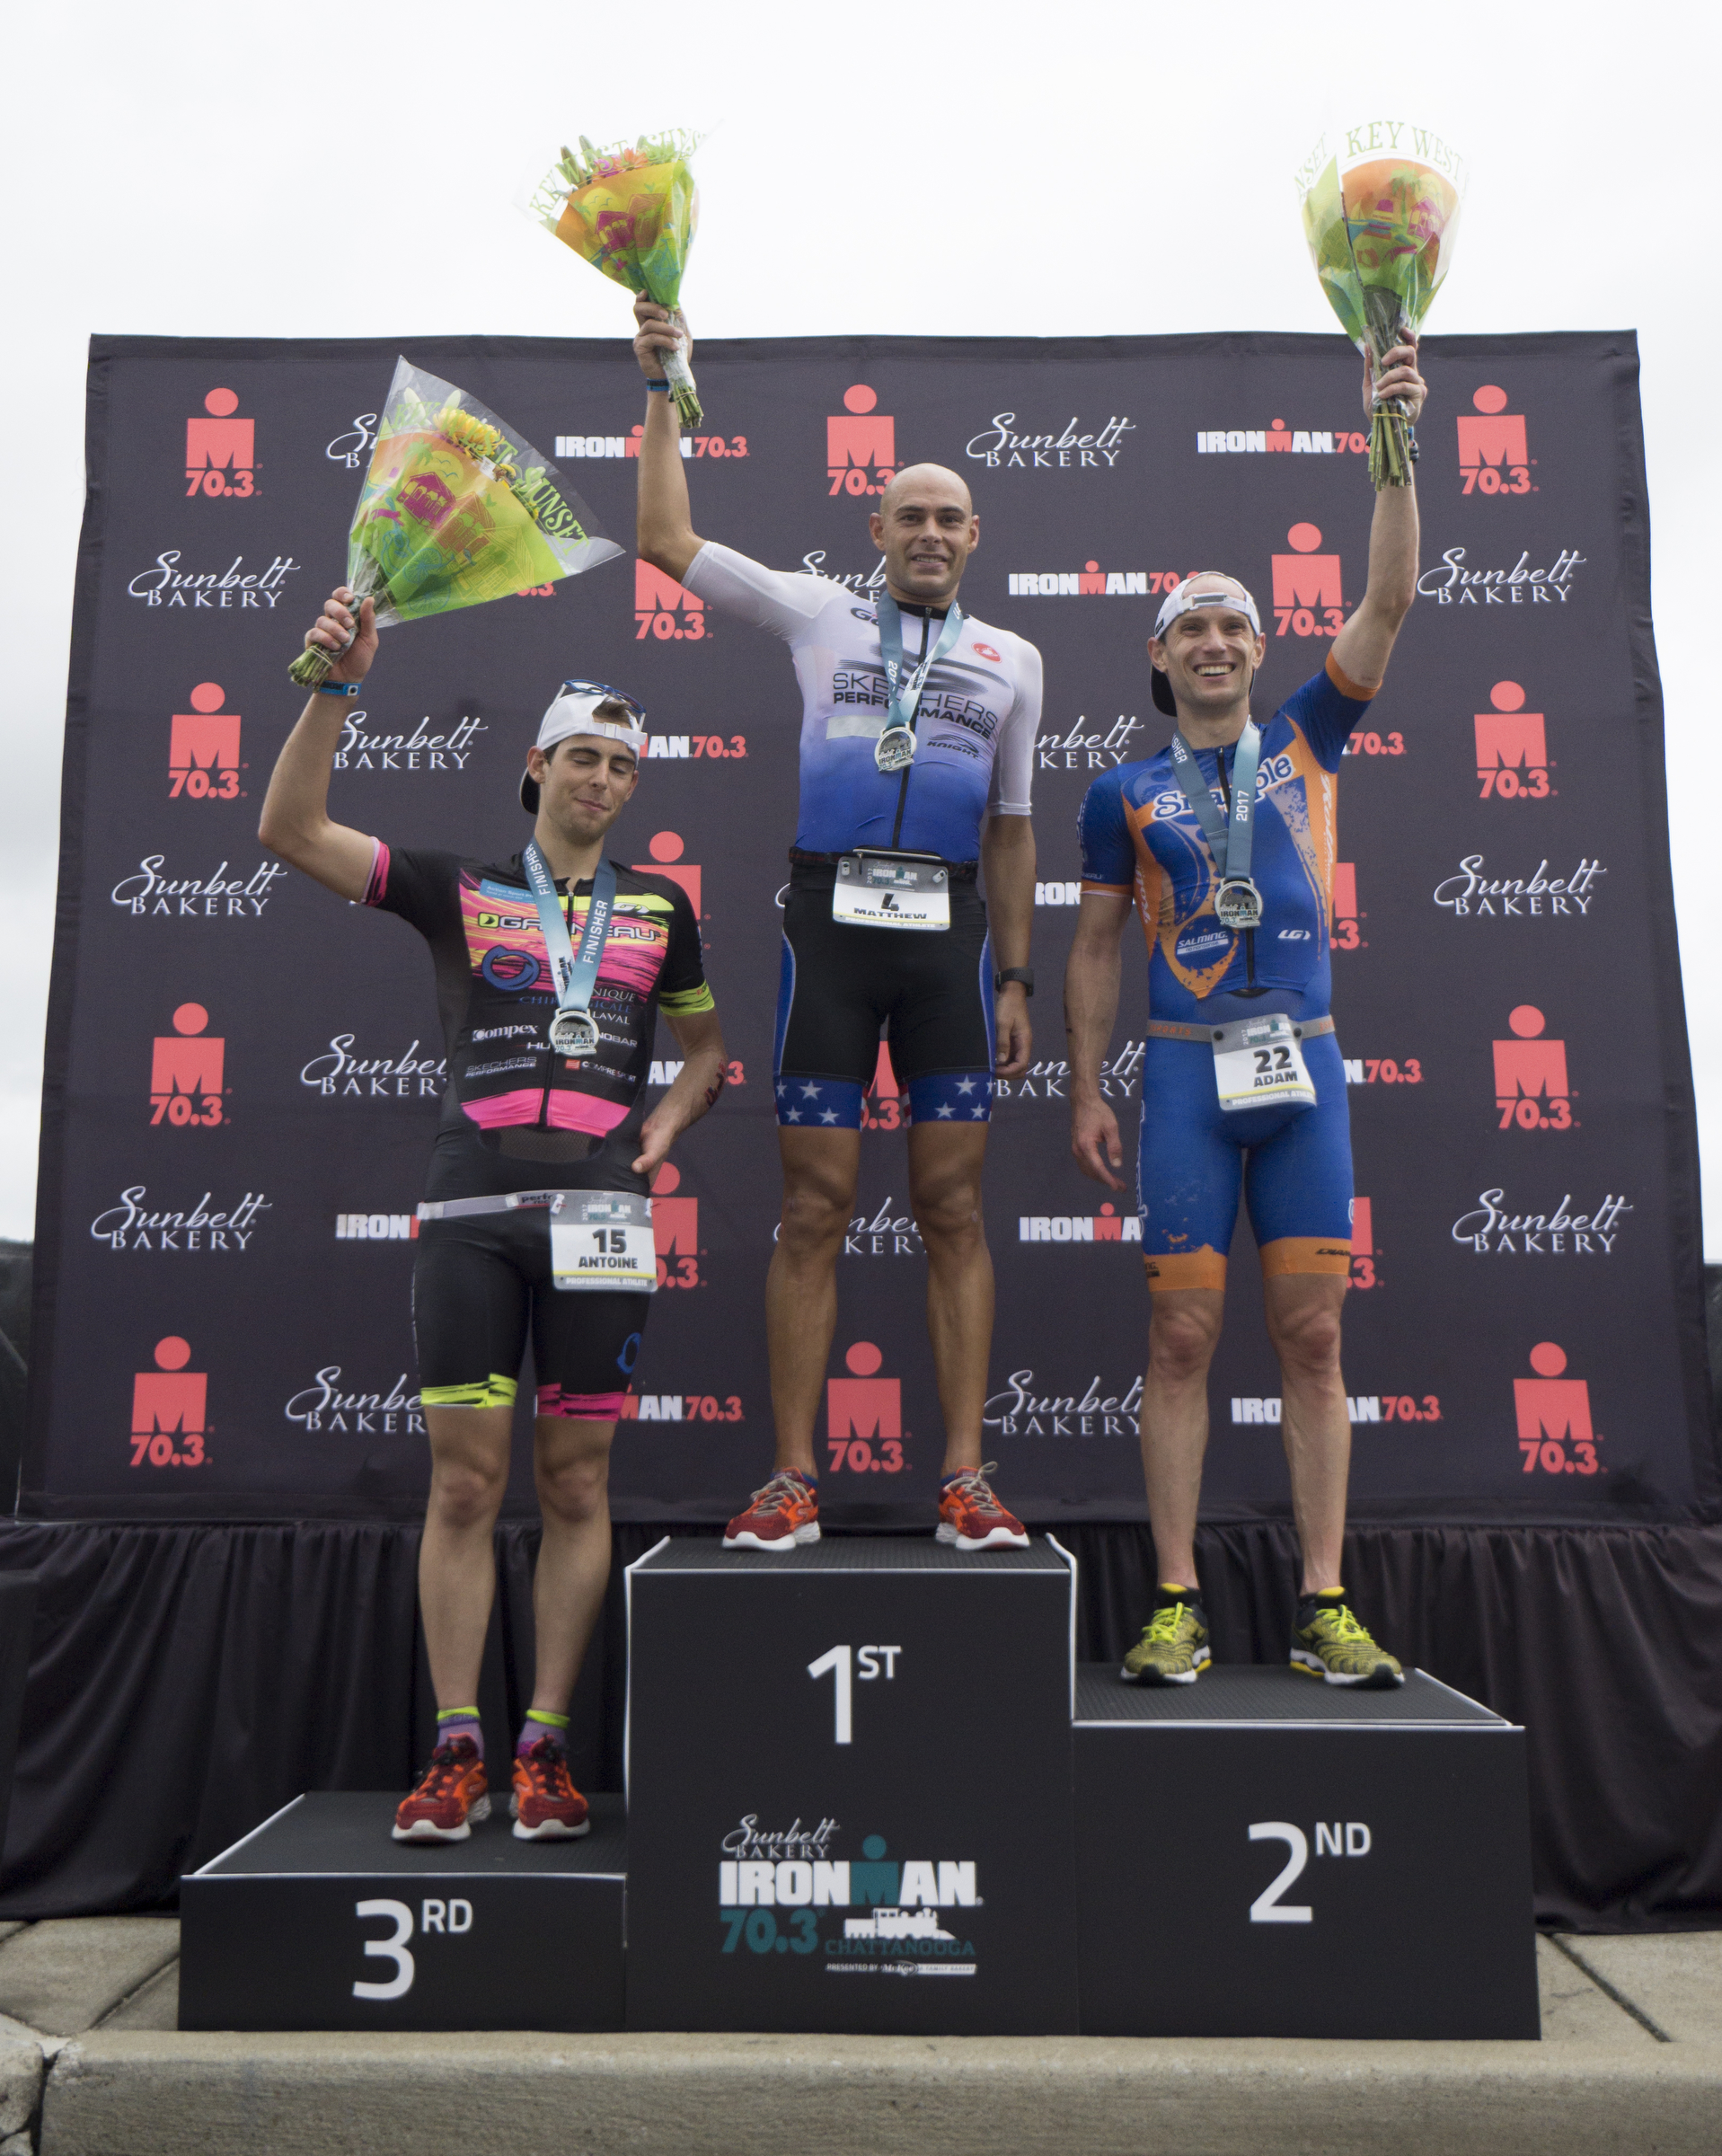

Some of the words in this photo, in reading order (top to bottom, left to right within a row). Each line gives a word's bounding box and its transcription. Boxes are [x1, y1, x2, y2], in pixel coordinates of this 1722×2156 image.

[1346, 120, 1404, 158] KEY
[1411, 125, 1463, 181] WEST
[529, 169, 568, 220] KEY
[555, 139, 629, 185] WEST
[694, 435, 748, 458] 70.3
[967, 412, 1135, 458] Sunbelt
[1197, 431, 1333, 454] IRONMAN
[986, 450, 1121, 467] BAKERY
[186, 471, 255, 498] 70.3
[1461, 468, 1532, 496] 70.3
[513, 466, 591, 557] SUNSET
[128, 550, 300, 596] Sunbelt
[1009, 572, 1148, 596] IRONMAN
[1417, 547, 1586, 595] Sunbelt
[146, 589, 284, 608] BAKERY
[1436, 586, 1572, 605] BAKERY
[635, 613, 706, 641] 70.3
[1274, 609, 1346, 638] 70.3
[833, 672, 998, 732] SKEHERS
[340, 711, 489, 753] Sunbelt
[1351, 732, 1406, 756] 70.3
[693, 736, 747, 759] 70.3
[926, 740, 979, 760] KNIGHT
[1038, 751, 1129, 769] KERY
[333, 752, 471, 770] BAKERY
[169, 771, 241, 800] 70.3
[1478, 770, 1551, 800] 70.3
[1235, 789, 1250, 822] 2017
[111, 854, 288, 905] Sunbelt
[1434, 854, 1608, 906] Sunbelt
[130, 897, 271, 916] BAKERY
[853, 906, 927, 920] MATTHEW
[881, 892, 900, 912] 4
[1454, 897, 1592, 916] BAKERY
[582, 899, 609, 965] FINISHER
[472, 1023, 539, 1042] Compex
[466, 1056, 538, 1073] SKECHERS
[1253, 1045, 1293, 1074] 22
[1365, 1059, 1423, 1084] 70.3
[321, 1077, 447, 1096] BAKER
[997, 1078, 1137, 1097] BAKRY
[1253, 1070, 1299, 1088] ADAM
[1232, 1091, 1290, 1106] PROFESSIONAL
[150, 1097, 224, 1127] 70.3
[1497, 1100, 1573, 1130] 70.3
[91, 1185, 273, 1242] Sunbelt
[1452, 1188, 1633, 1243] Sunbelt
[110, 1229, 255, 1250] BAKERY
[592, 1228, 628, 1254] 15
[1020, 1215, 1142, 1241] IRONMA
[1473, 1233, 1617, 1253] BAKERY
[578, 1256, 639, 1269] ANTOINE
[565, 1277, 622, 1286] PROFESSIONAL
[623, 1277, 648, 1286] ATHLETE
[285, 1365, 425, 1420] Sunbe
[305, 1410, 428, 1433] BAKER
[685, 1396, 743, 1422] 70.3
[1382, 1396, 1442, 1422] 70.3
[130, 1435, 206, 1468] 70.3
[828, 1441, 905, 1473] 70.3
[1520, 1442, 1600, 1475] 70.3
[721, 1813, 841, 1853] Sunbelt
[734, 1844, 829, 1860] BAKERY
[719, 1860, 977, 1906] IRONMAN
[720, 1908, 819, 1954] 70.3
[825, 1940, 976, 1957] CHATTANOOGA
[826, 1963, 869, 1972] PRESENTED
[869, 1963, 878, 1972] BY
